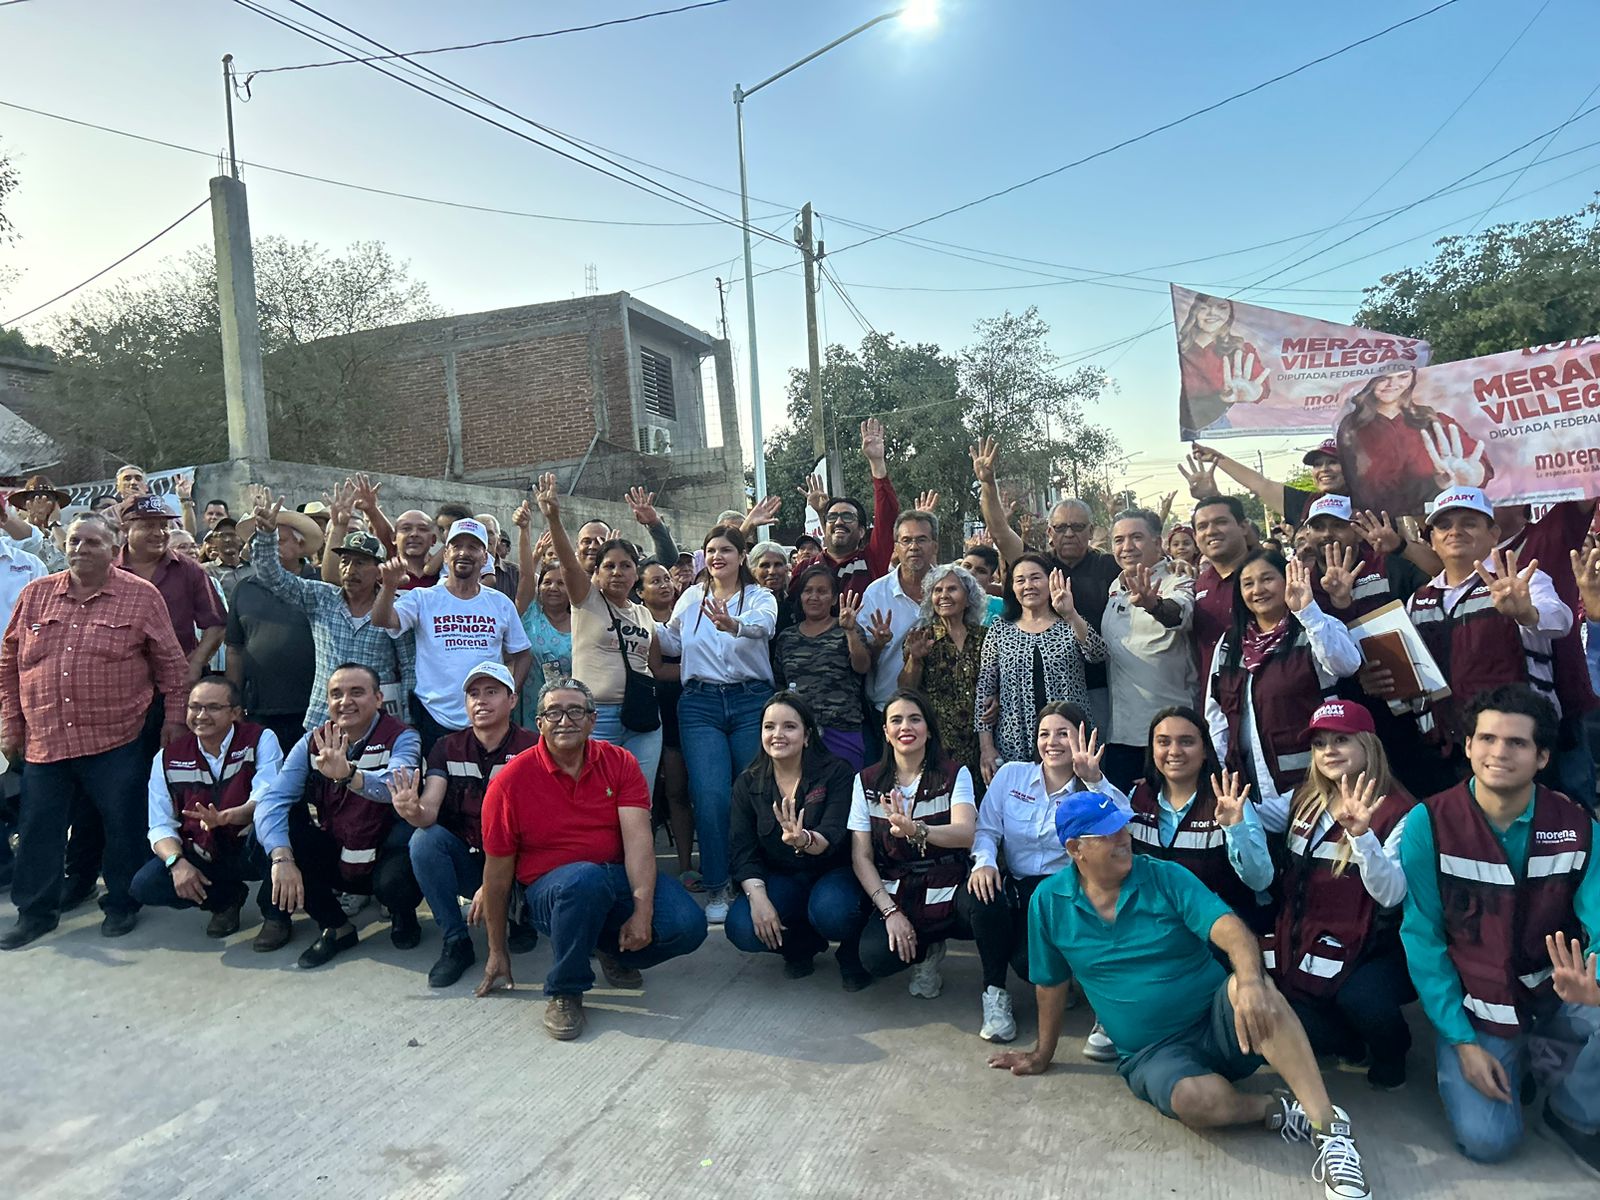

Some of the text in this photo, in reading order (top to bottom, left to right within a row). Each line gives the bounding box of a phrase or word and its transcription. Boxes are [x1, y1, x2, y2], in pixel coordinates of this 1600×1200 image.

[1281, 337, 1420, 354] MERARY
[1281, 348, 1418, 371] VILLEGAS
[1277, 371, 1327, 381] DIPUTADA
[1329, 368, 1375, 379] FEDERAL
[1473, 352, 1600, 403] MERA
[1480, 383, 1600, 424] VILLEG
[1489, 421, 1551, 440] DIPUTADA
[1534, 447, 1600, 470] moren
[433, 615, 496, 625] KRISTIAM
[434, 624, 496, 634] ESPINOZA
[445, 638, 488, 647] morena
[1536, 829, 1577, 840] morena
